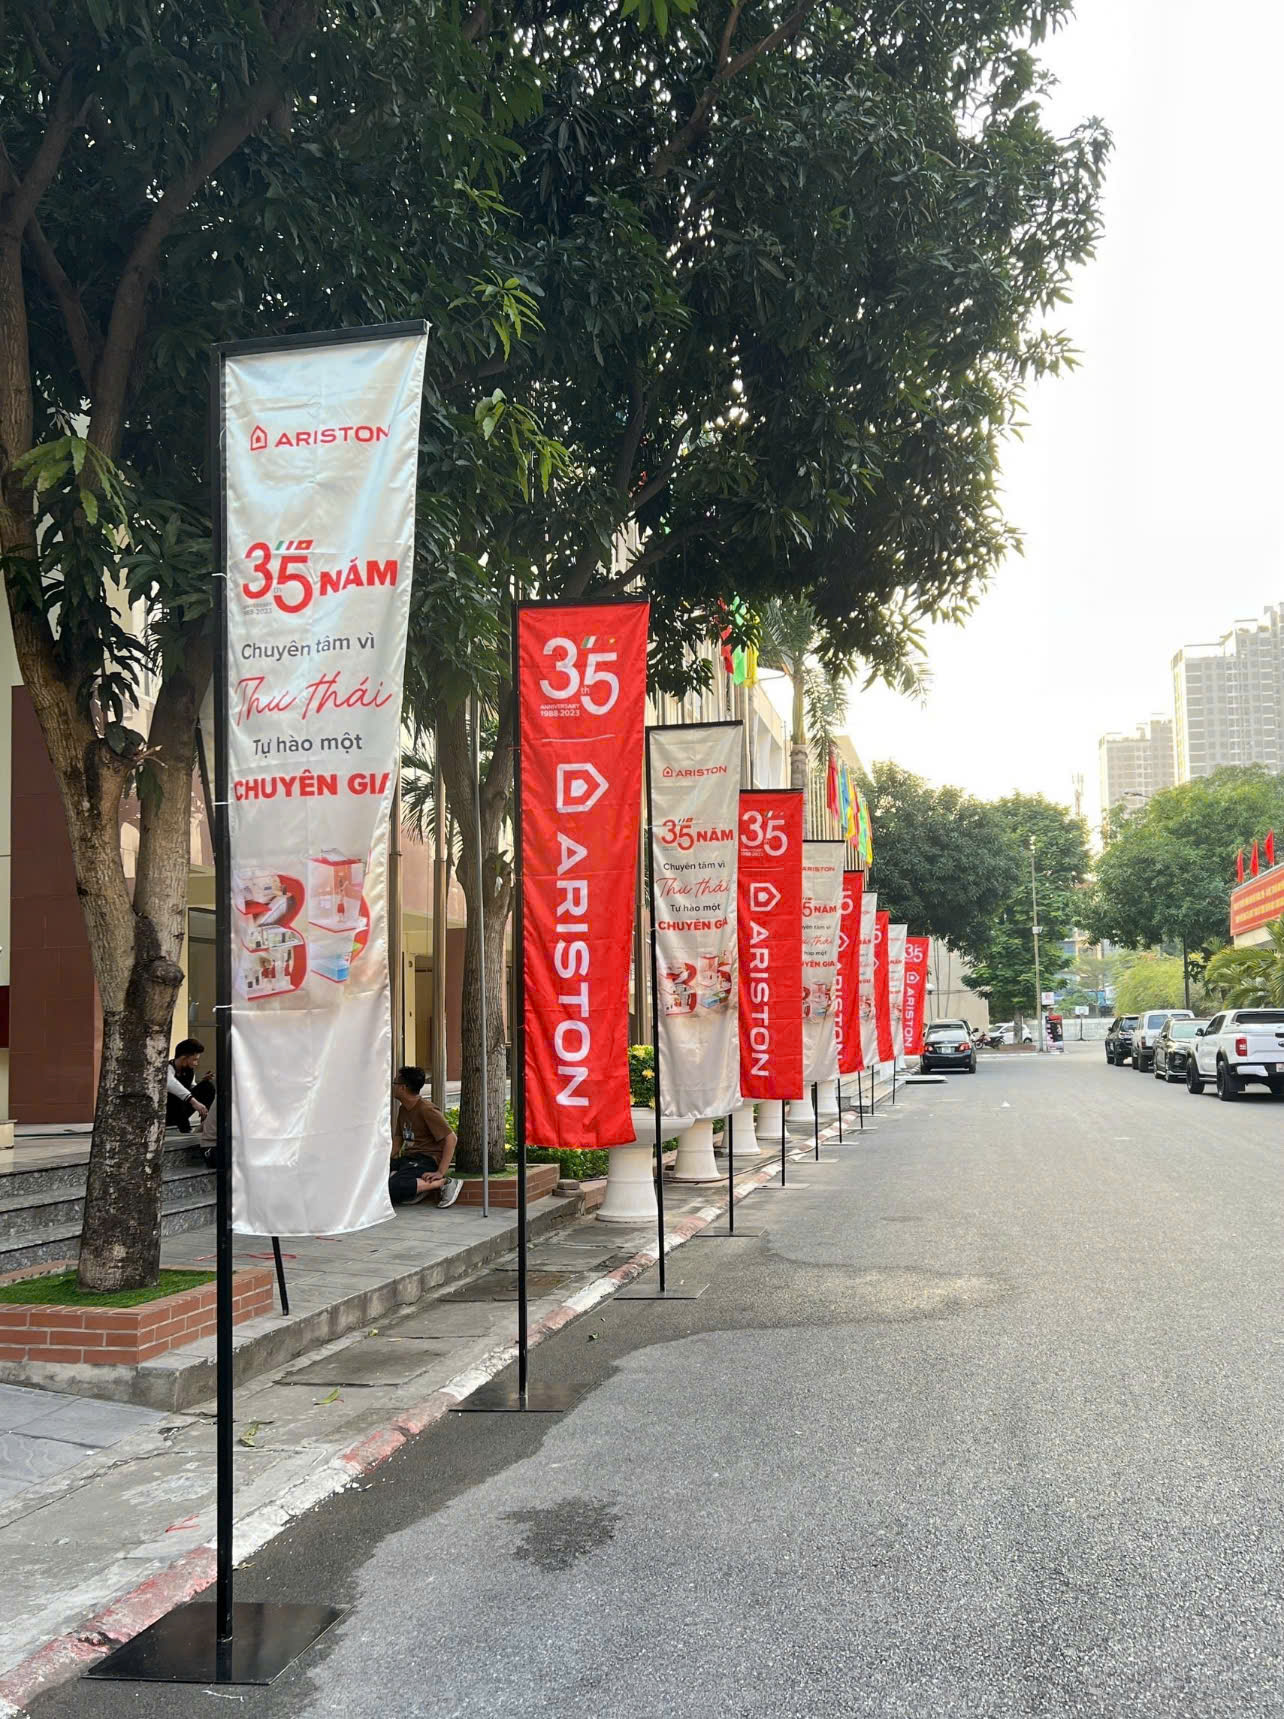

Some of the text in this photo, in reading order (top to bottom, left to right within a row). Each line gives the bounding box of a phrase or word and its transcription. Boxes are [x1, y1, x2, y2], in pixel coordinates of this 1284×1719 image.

[275, 425, 391, 448] ARISTON
[242, 542, 313, 614] 35
[241, 632, 375, 661] Chuyên tâm vì
[540, 637, 620, 715] 35
[235, 671, 393, 727] Thư thái
[253, 732, 363, 758] Tự hào một
[234, 769, 339, 801] CHUYÊN
[675, 765, 728, 777] ARISTON
[661, 819, 695, 851] 35
[740, 810, 788, 857] 35
[663, 861, 696, 873] Chuyên
[702, 902, 721, 913] một
[802, 900, 813, 917] 5
[840, 890, 853, 915] 5
[658, 918, 712, 931] CHUYÊN
[904, 944, 924, 962] 35
[553, 831, 591, 1107] ARISTON
[750, 920, 769, 1077] ARISTON
[904, 986, 915, 1048] ARISTON
